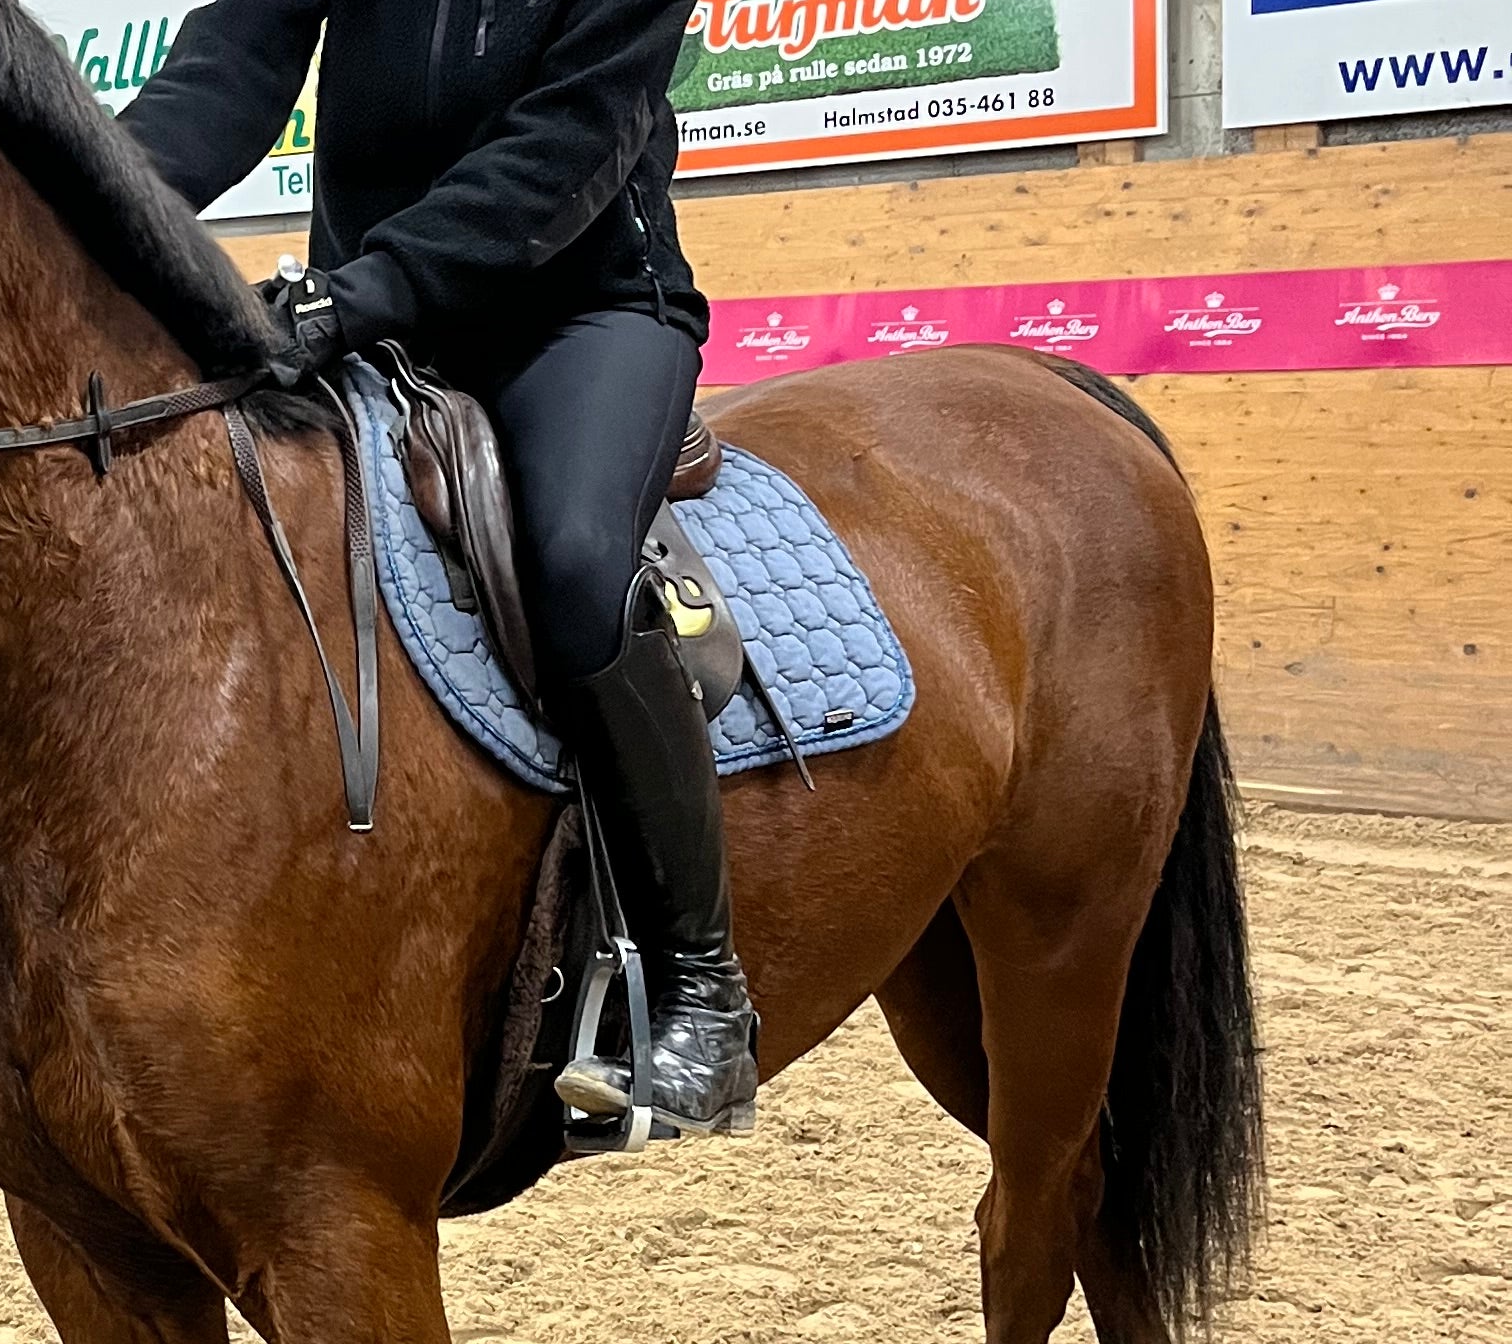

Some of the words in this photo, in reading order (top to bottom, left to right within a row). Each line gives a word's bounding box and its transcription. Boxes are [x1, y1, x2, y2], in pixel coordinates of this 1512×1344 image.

[707, 71, 753, 94] Gräs
[759, 65, 784, 91] på
[790, 57, 839, 83] rulle
[844, 54, 908, 77] sedan
[916, 42, 973, 69] 1972
[1338, 46, 1512, 93] www.
[823, 101, 920, 129] Halmstad
[927, 92, 1016, 118] 035-461
[1028, 88, 1055, 108] 88
[272, 163, 310, 195] Tel
[1334, 305, 1398, 326] Anthon
[1375, 304, 1441, 331] Berg
